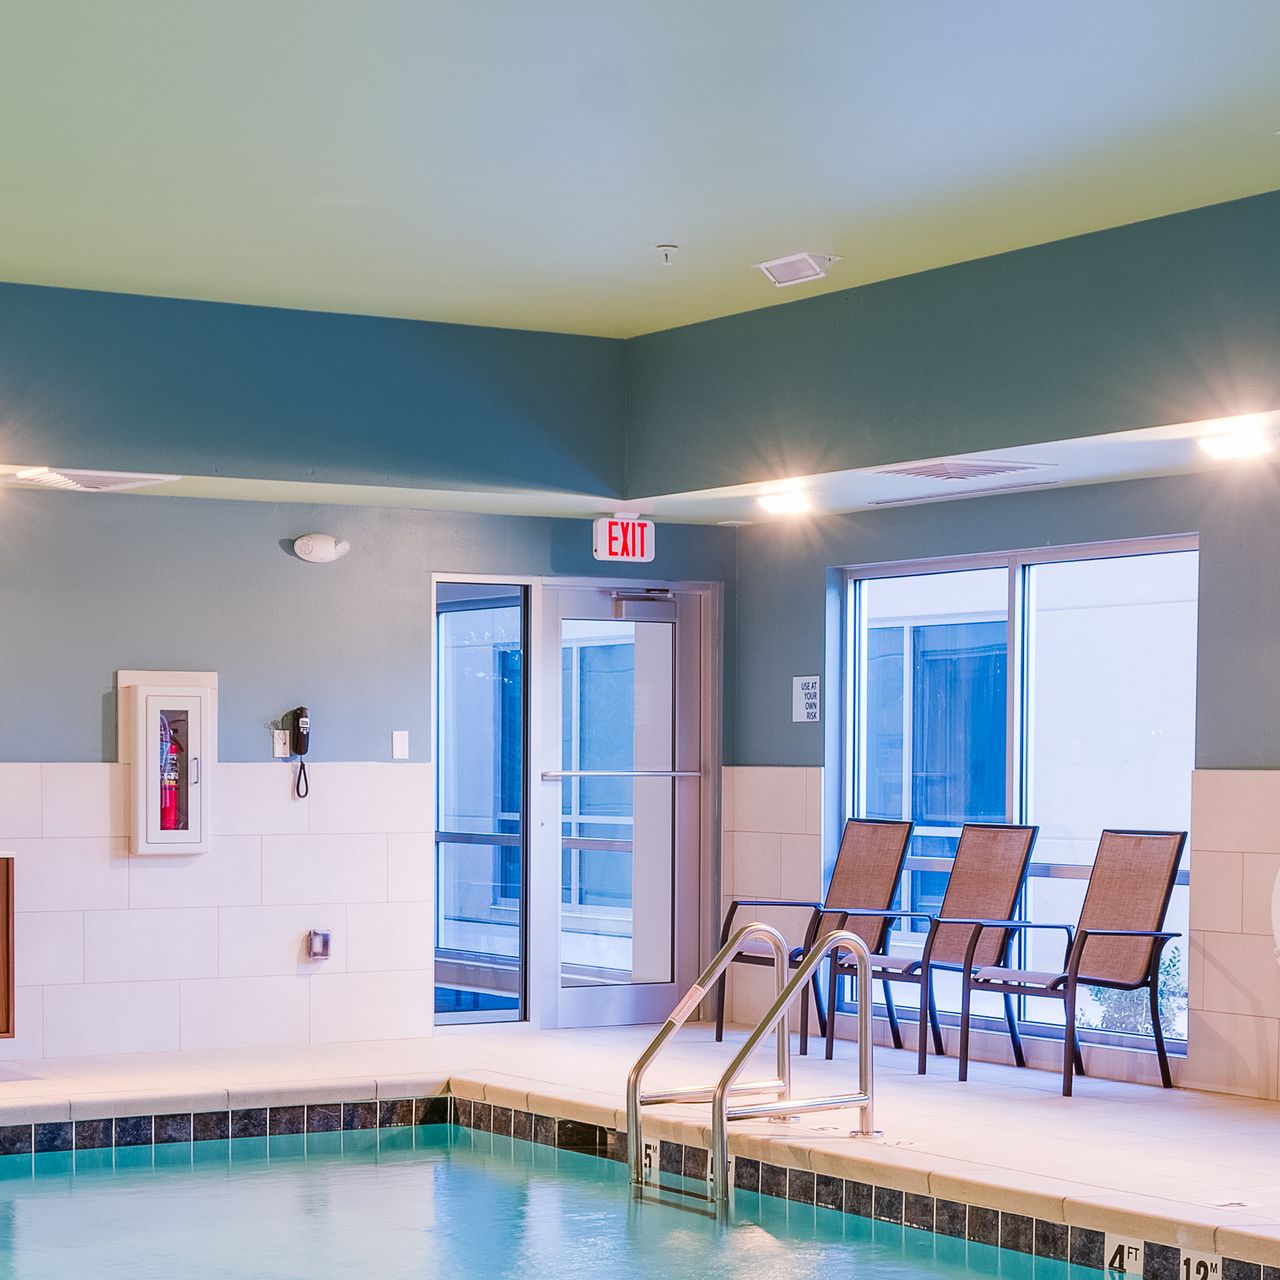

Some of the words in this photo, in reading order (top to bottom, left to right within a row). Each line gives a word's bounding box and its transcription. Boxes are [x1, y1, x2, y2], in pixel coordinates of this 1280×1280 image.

[608, 521, 647, 557] EXIT
[801, 682, 810, 690] USE
[811, 682, 817, 690] AT
[804, 692, 817, 700] YOUR
[805, 702, 817, 710] OWN
[806, 712, 817, 720] RISK
